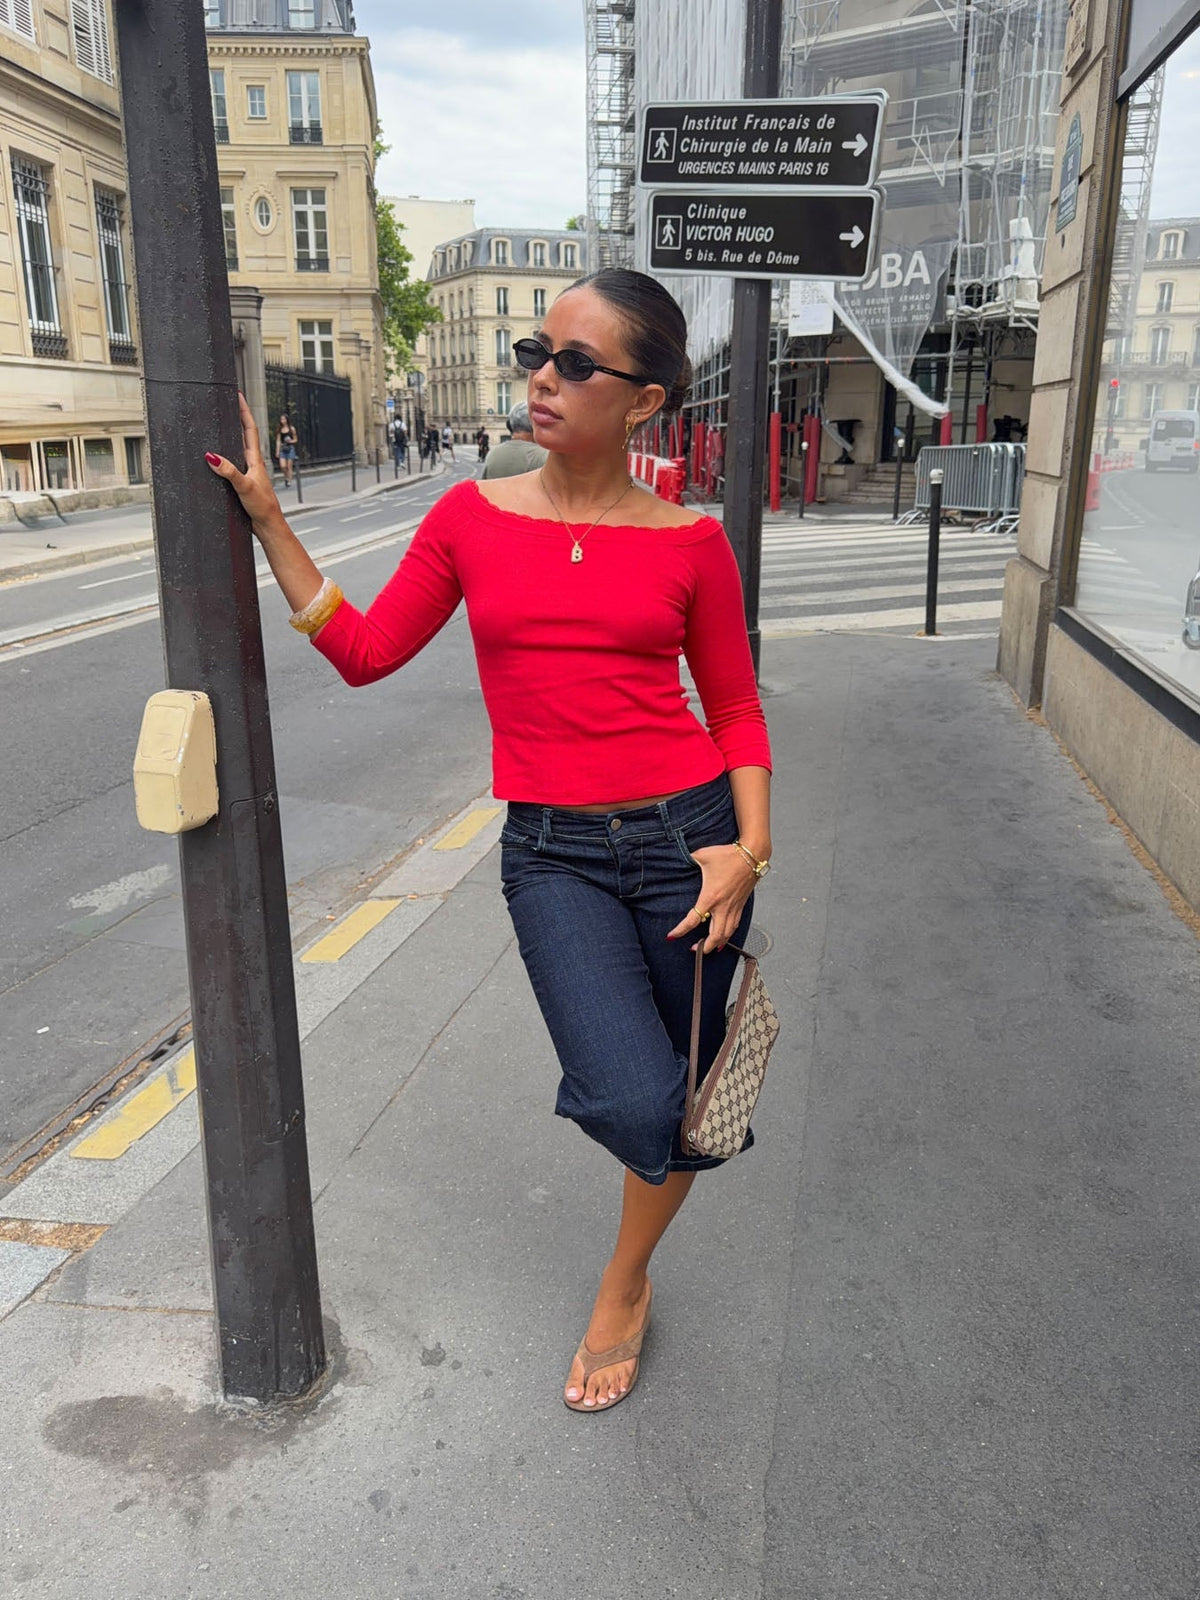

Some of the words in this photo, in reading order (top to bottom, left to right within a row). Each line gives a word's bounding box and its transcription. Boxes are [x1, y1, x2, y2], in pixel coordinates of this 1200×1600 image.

[682, 114, 738, 131] Institut
[743, 113, 810, 131] Français
[816, 113, 836, 130] de
[680, 137, 747, 158] Chirurgie
[751, 137, 769, 153] de
[773, 137, 789, 153] la
[793, 136, 832, 153] Main
[678, 161, 736, 174] URGENCES
[737, 161, 776, 175] MAINS
[777, 161, 814, 175] PARIS
[815, 161, 830, 176] 16
[687, 203, 747, 223] Clinique
[686, 224, 732, 241] VICTOR
[735, 225, 775, 243] HUGO
[684, 248, 693, 261] 5
[696, 249, 717, 262] bis.
[721, 249, 743, 262] Rue
[747, 250, 762, 263] de
[766, 250, 800, 265] Dôme
